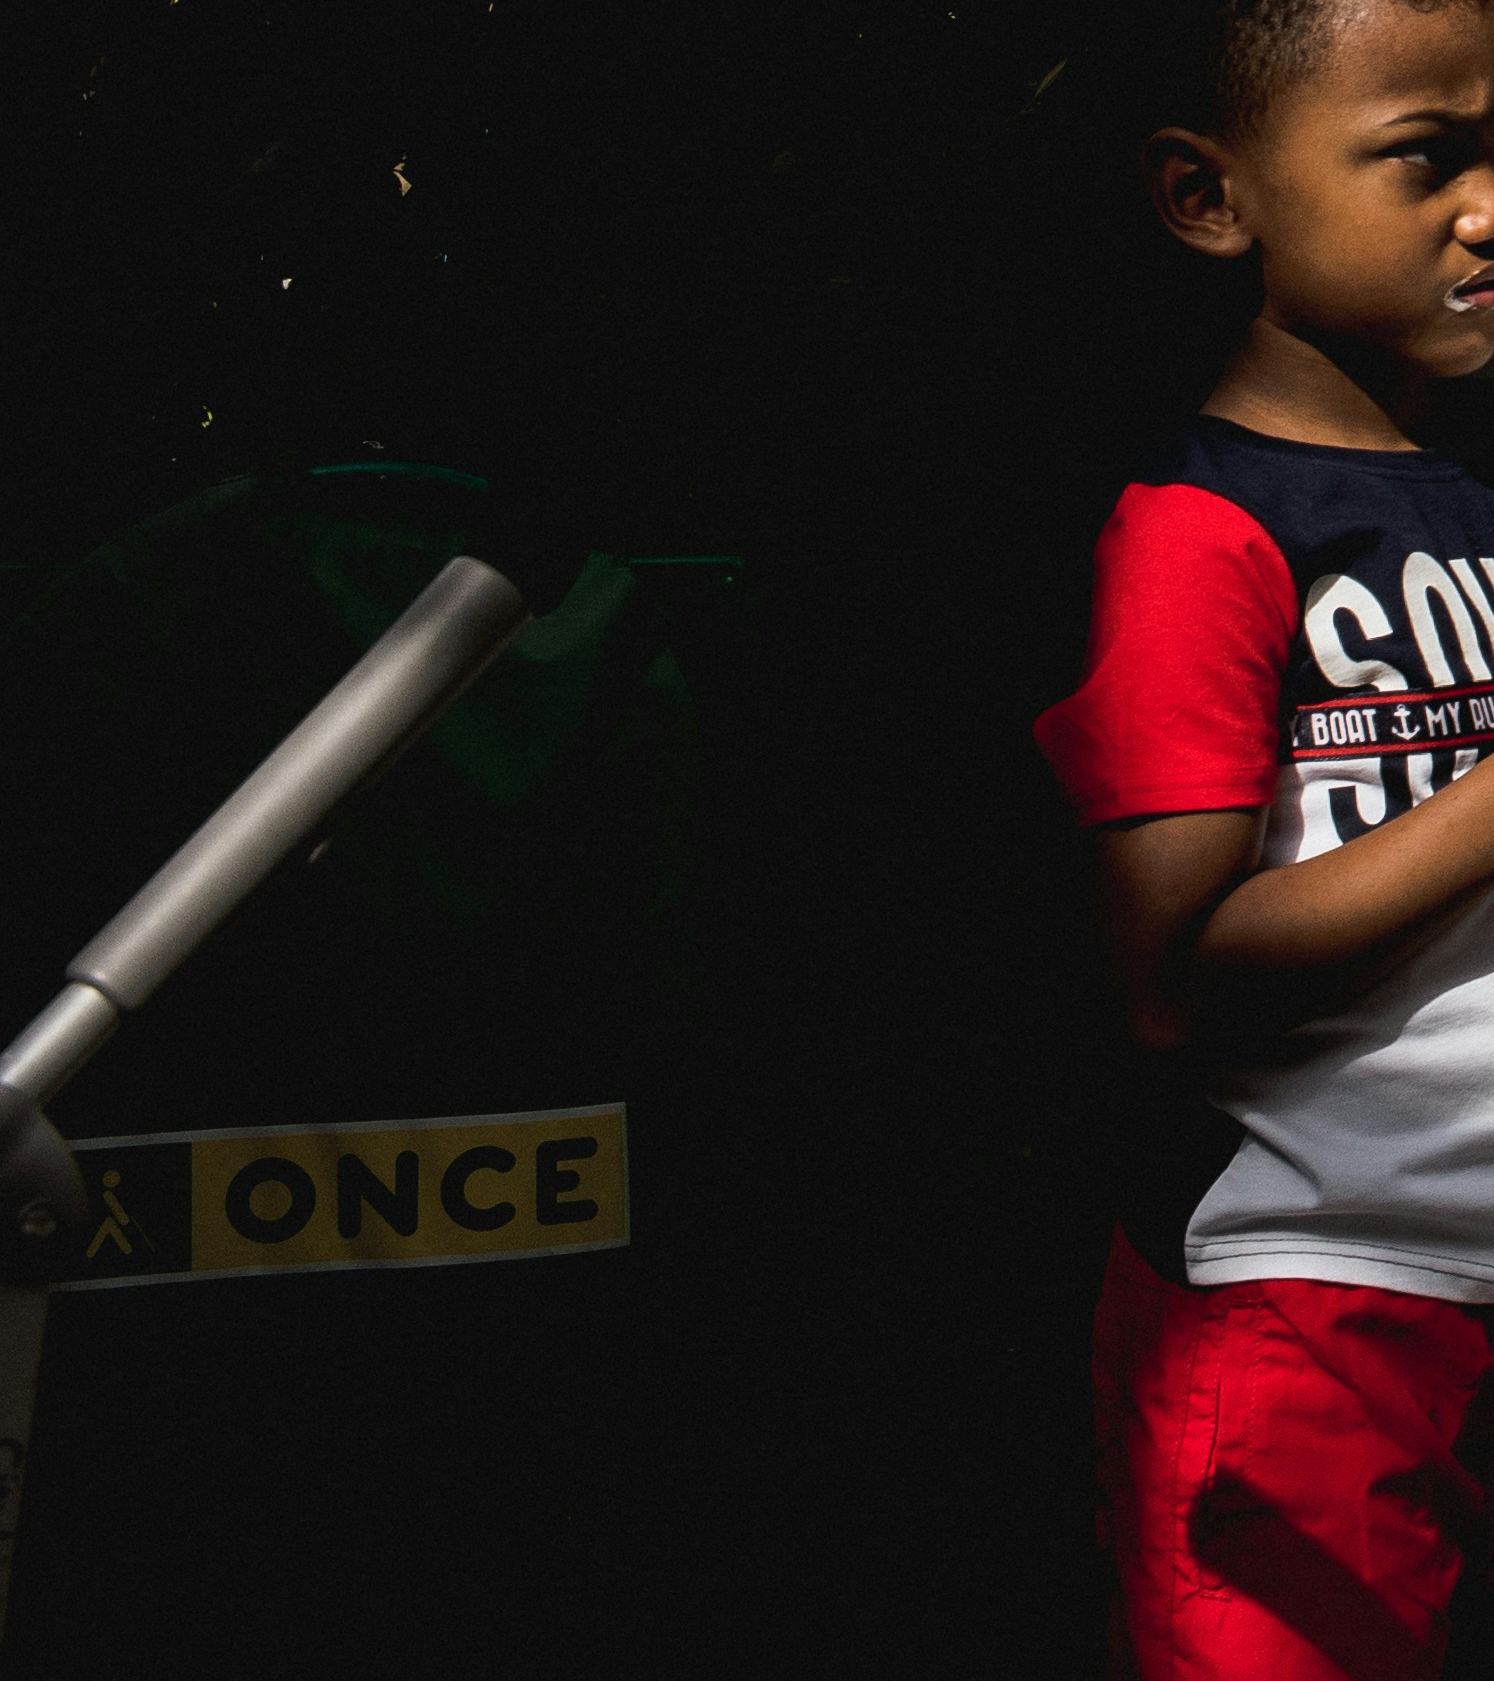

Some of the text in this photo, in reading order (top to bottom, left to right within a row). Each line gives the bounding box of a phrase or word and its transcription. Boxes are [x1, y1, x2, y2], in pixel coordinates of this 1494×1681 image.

[1311, 709, 1378, 746] BOAT
[1426, 702, 1462, 736] MY
[224, 1136, 599, 1244] ONCE
